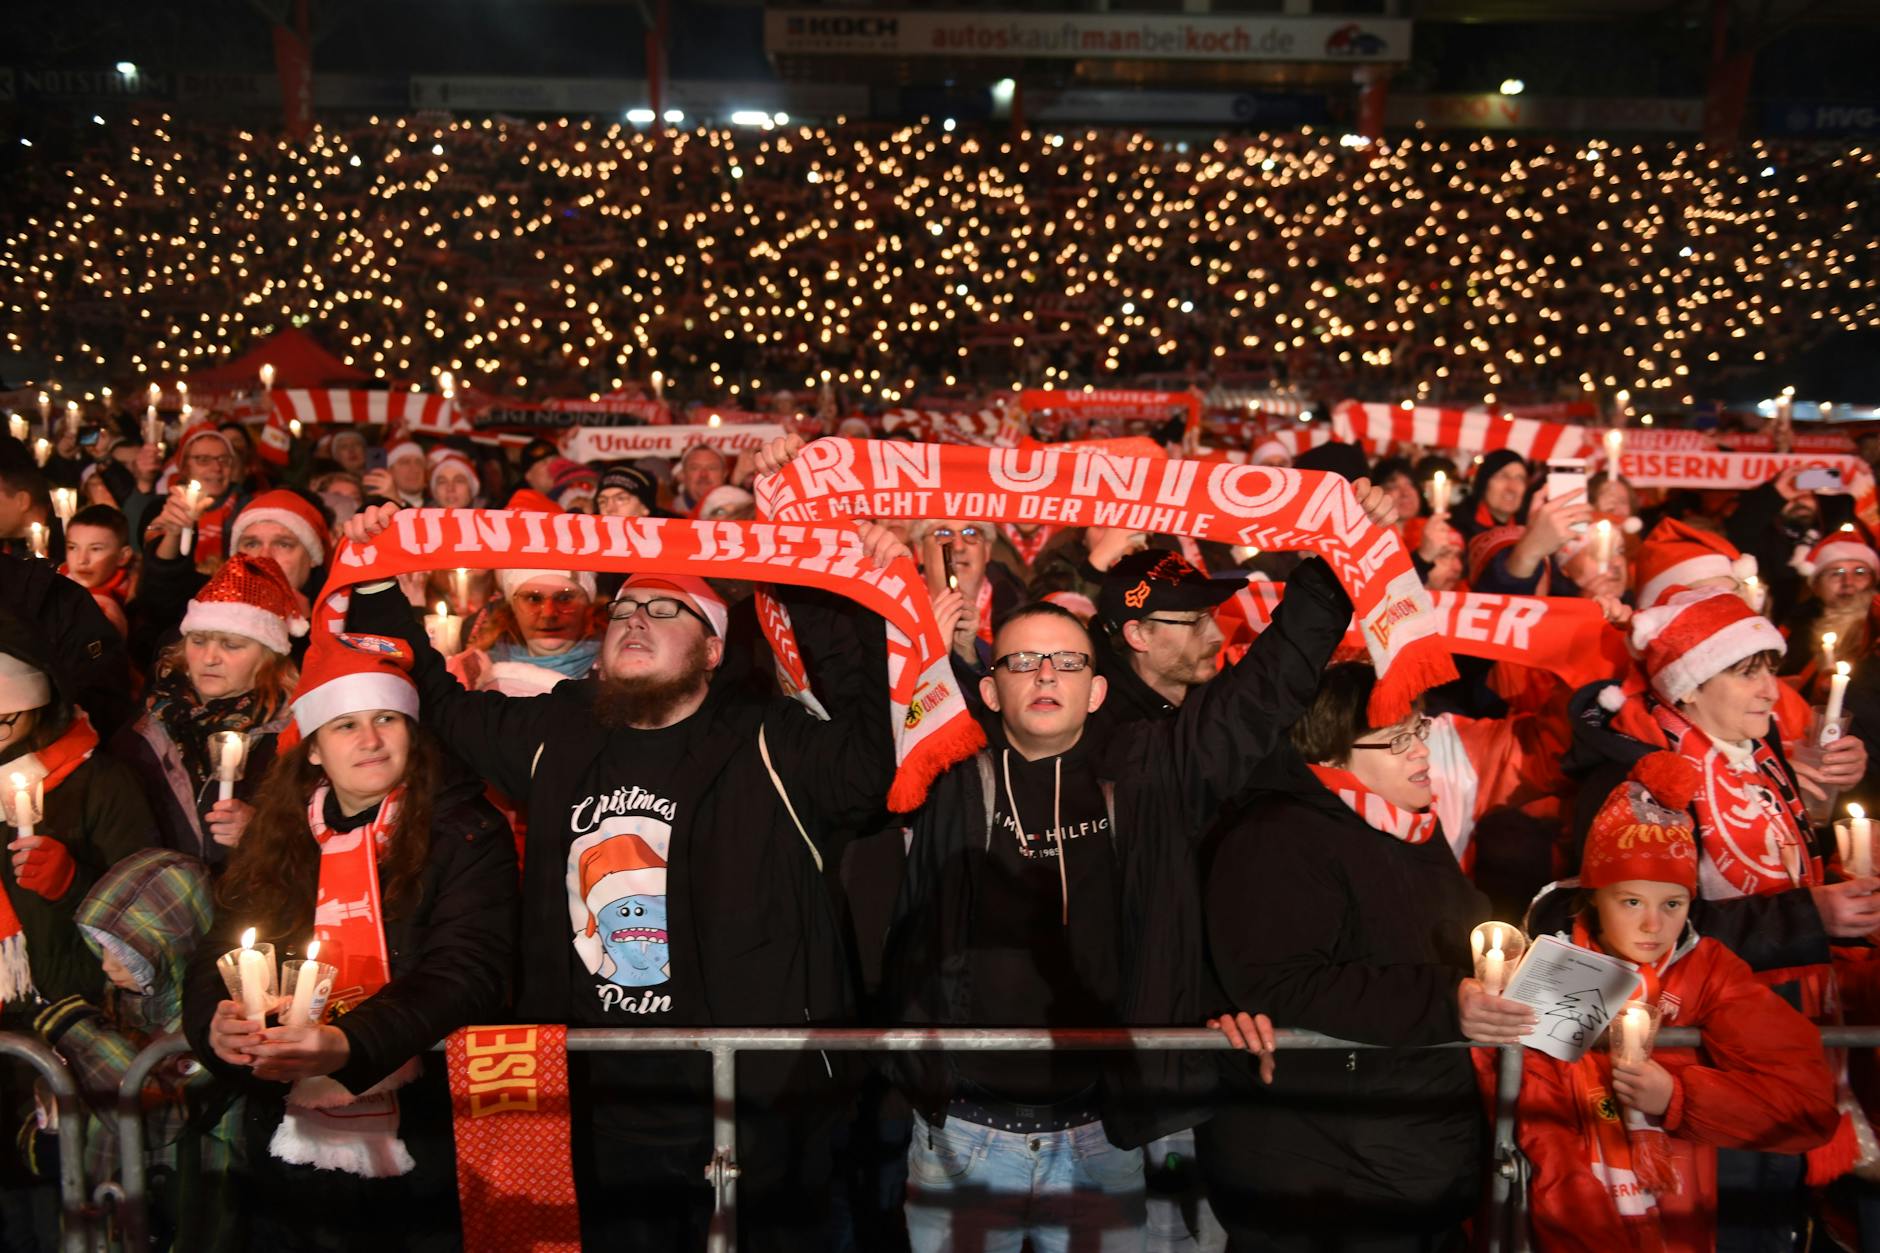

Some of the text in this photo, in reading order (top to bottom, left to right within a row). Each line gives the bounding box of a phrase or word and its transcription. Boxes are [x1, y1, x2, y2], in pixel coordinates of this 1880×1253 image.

[809, 17, 898, 36] KOCH
[589, 432, 763, 451] Union Berlin
[1620, 453, 1729, 480] EISERN
[988, 447, 1372, 548] UNION
[828, 491, 932, 517] MACHT
[944, 492, 1007, 518] VON
[1018, 495, 1083, 523] DER
[1092, 501, 1216, 538] WUHLE
[393, 508, 670, 559] UNION
[920, 682, 950, 713] UNION
[596, 983, 674, 1014] Pain
[466, 1028, 539, 1119] EISE
